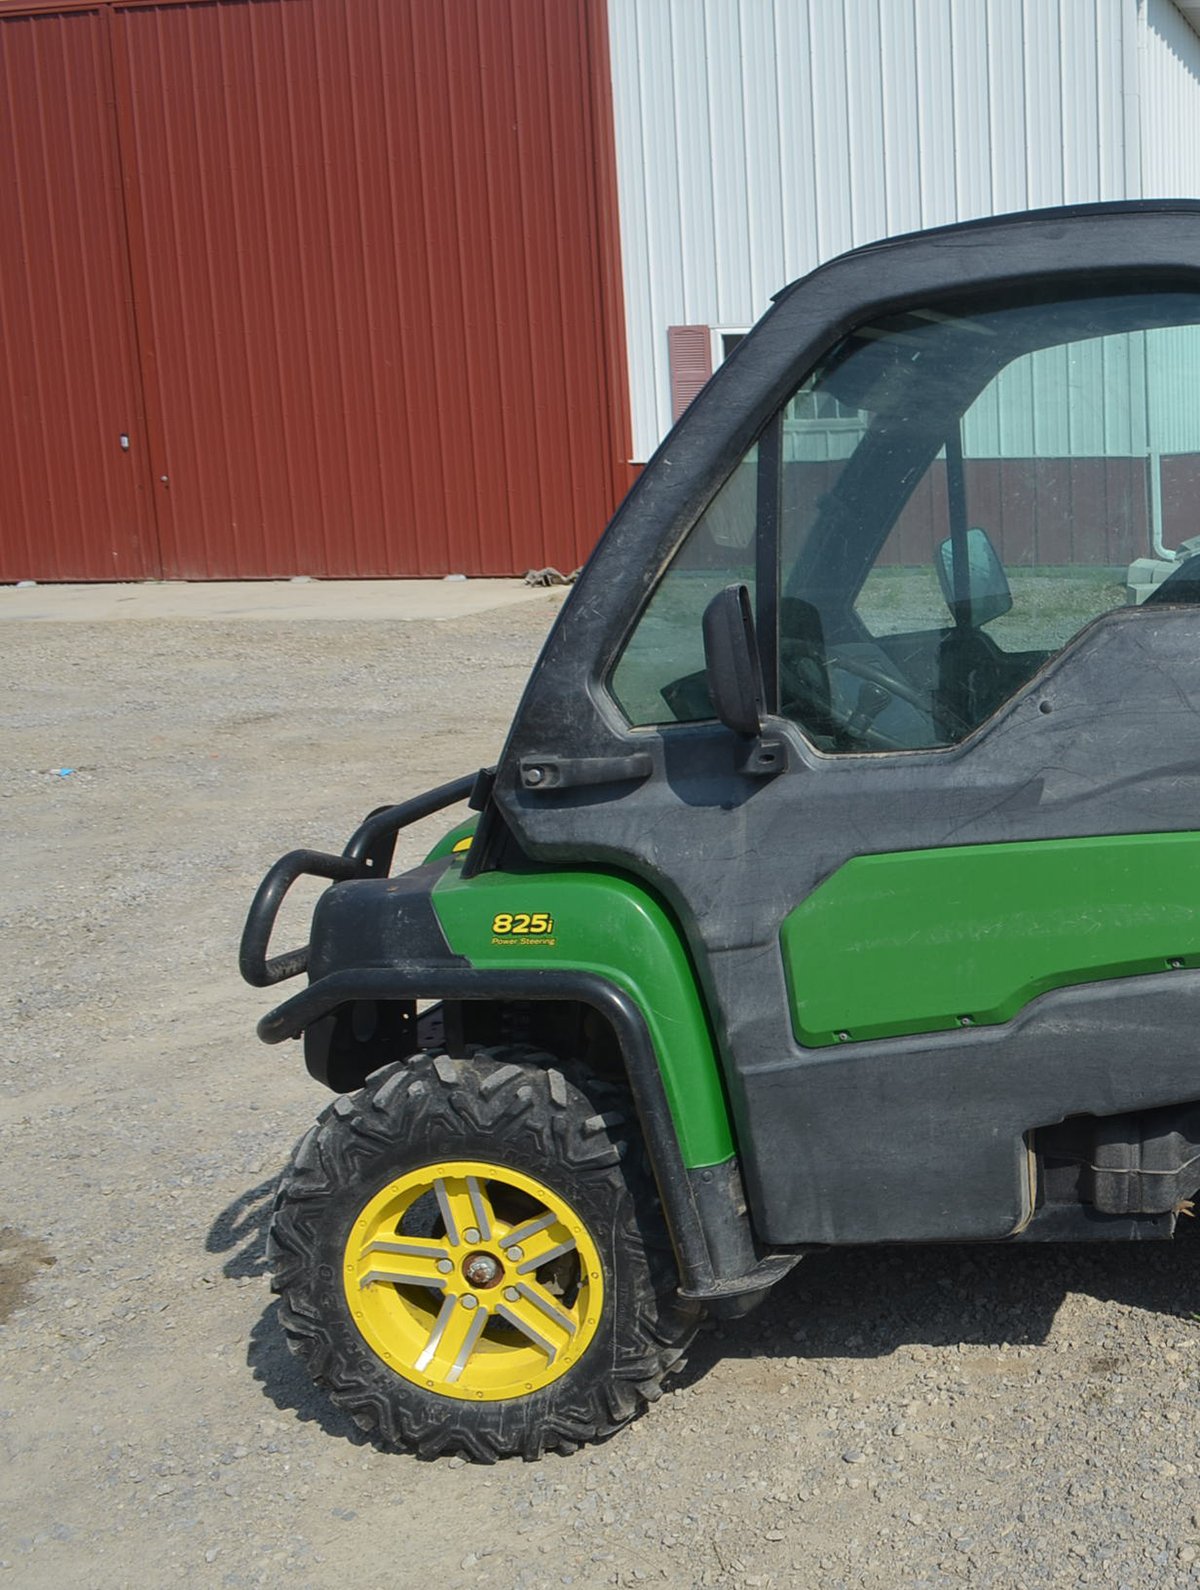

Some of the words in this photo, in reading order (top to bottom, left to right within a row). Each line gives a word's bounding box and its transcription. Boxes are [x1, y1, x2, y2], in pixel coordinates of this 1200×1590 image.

[492, 913, 553, 934] 825i
[491, 937, 518, 946] Power
[519, 937, 556, 947] Steering
